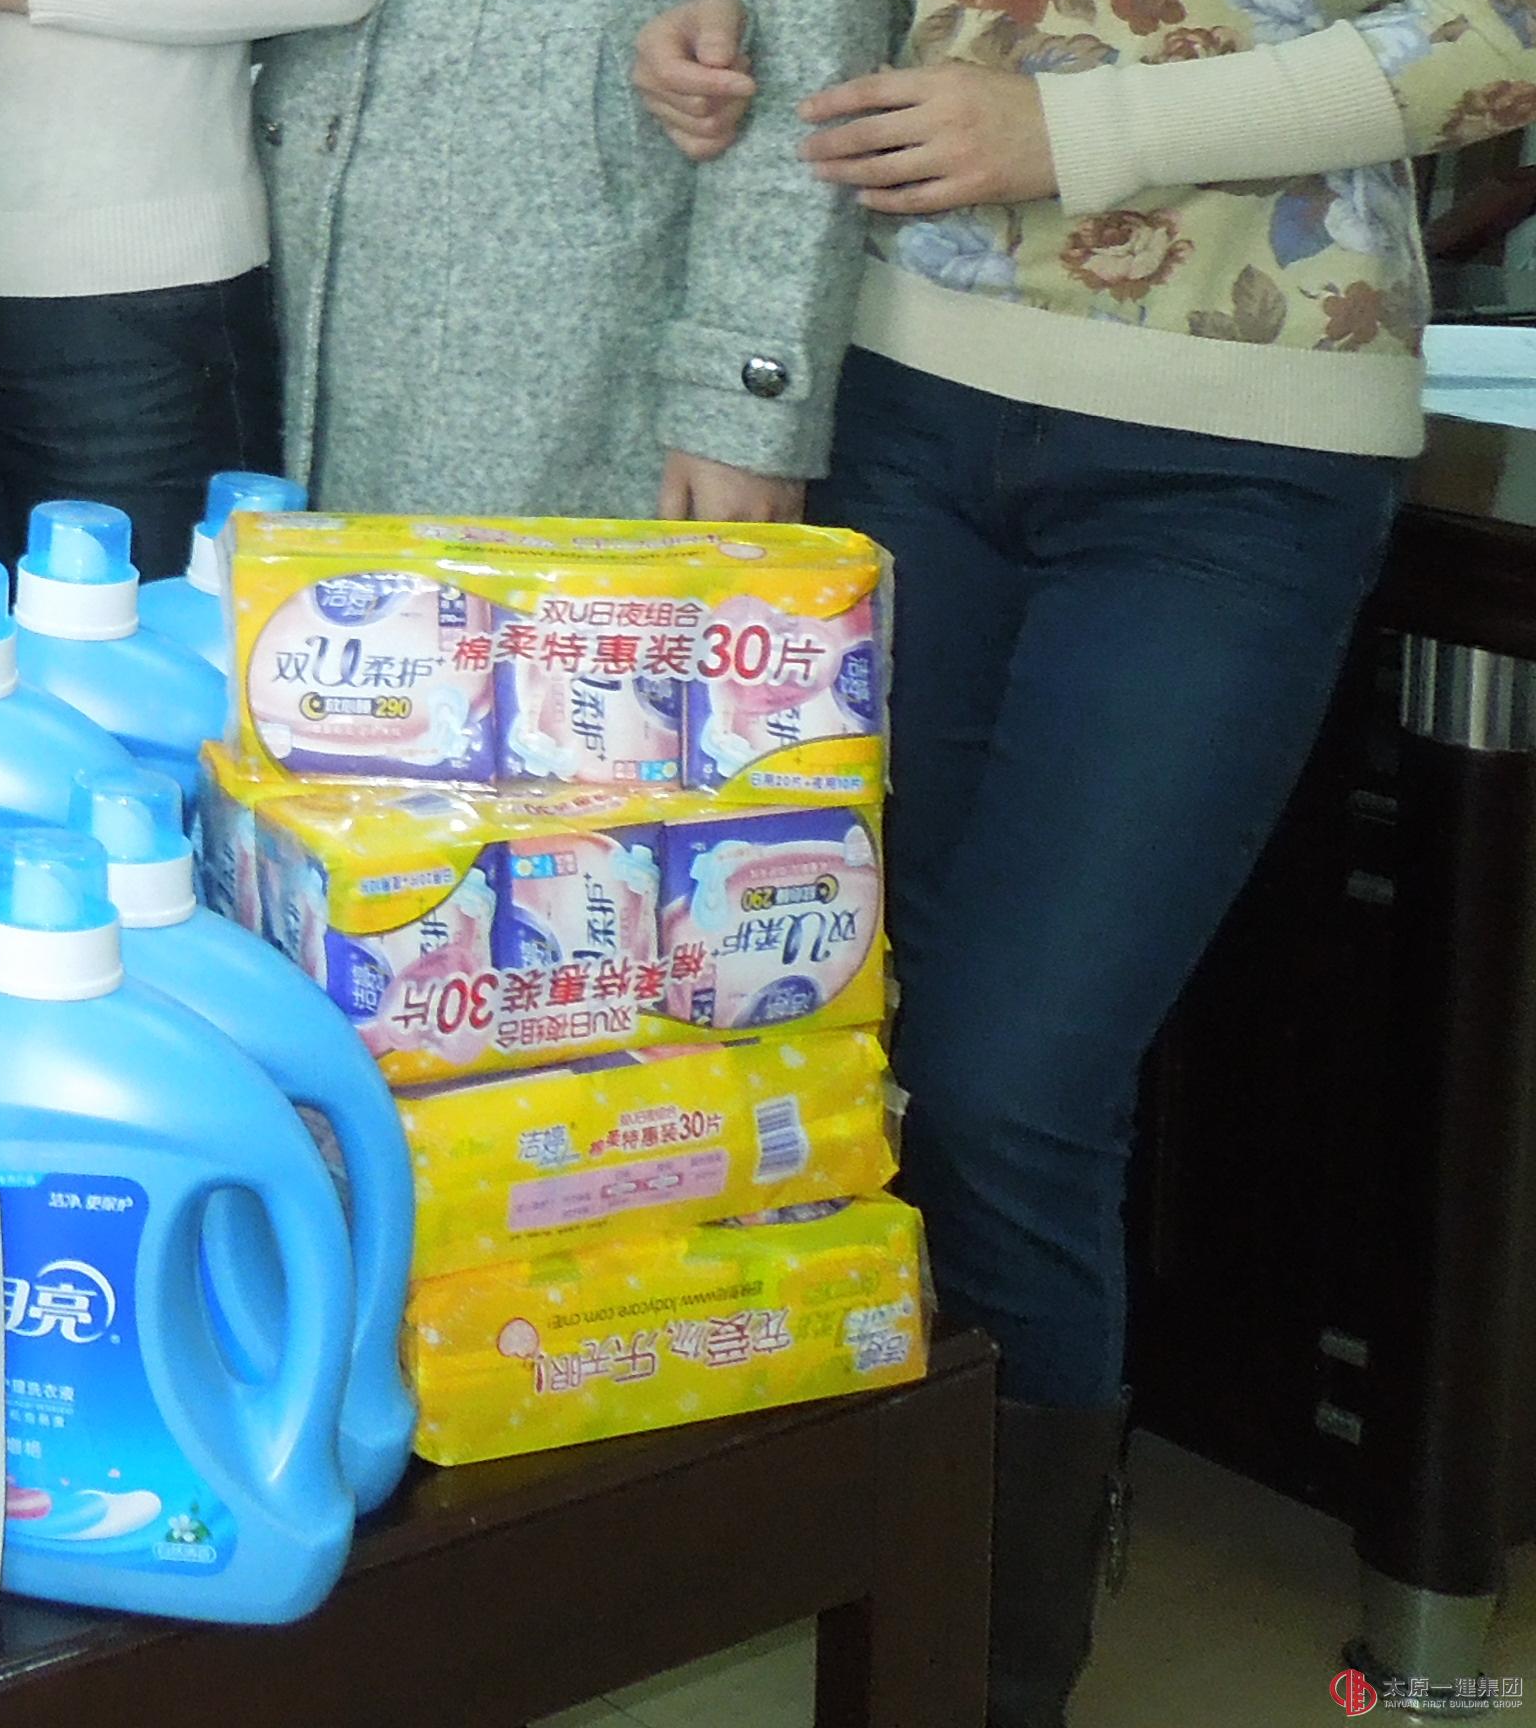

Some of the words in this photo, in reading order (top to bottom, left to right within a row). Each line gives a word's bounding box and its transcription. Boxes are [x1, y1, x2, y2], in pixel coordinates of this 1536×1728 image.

[540, 599, 703, 627] 双U日夜组合
[451, 623, 826, 682] 棉柔特惠装30片
[374, 695, 413, 719] 290
[392, 940, 707, 1036] 棉柔特惠装30片
[495, 1006, 633, 1048] 双U日夜组合
